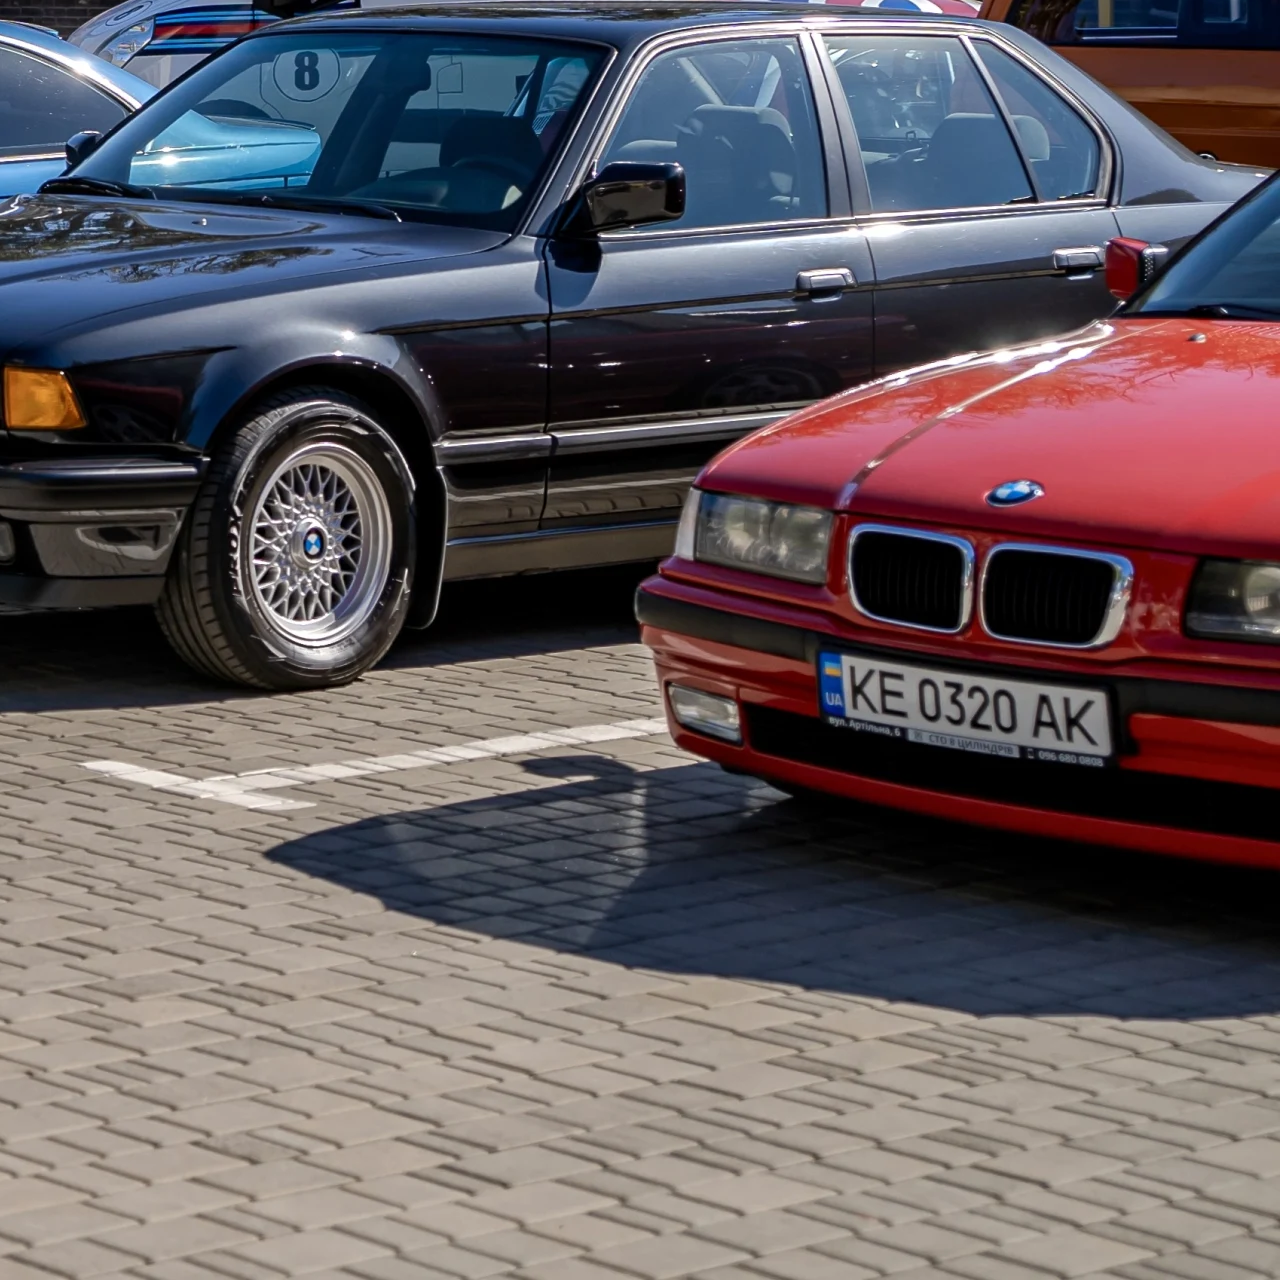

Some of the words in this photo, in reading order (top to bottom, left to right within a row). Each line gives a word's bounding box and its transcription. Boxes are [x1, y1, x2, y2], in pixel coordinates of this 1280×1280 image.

[113, 4, 145, 21] 8
[294, 51, 320, 91] 8
[825, 692, 843, 707] UA
[849, 665, 908, 718] KE
[918, 678, 1018, 734] 0320
[1032, 693, 1099, 746] AK
[828, 717, 848, 727] вул.
[894, 727, 901, 737] 6
[929, 734, 947, 745] СТО
[957, 738, 1014, 756] ЦИЛІНДРІВ
[1038, 750, 1058, 761] 096
